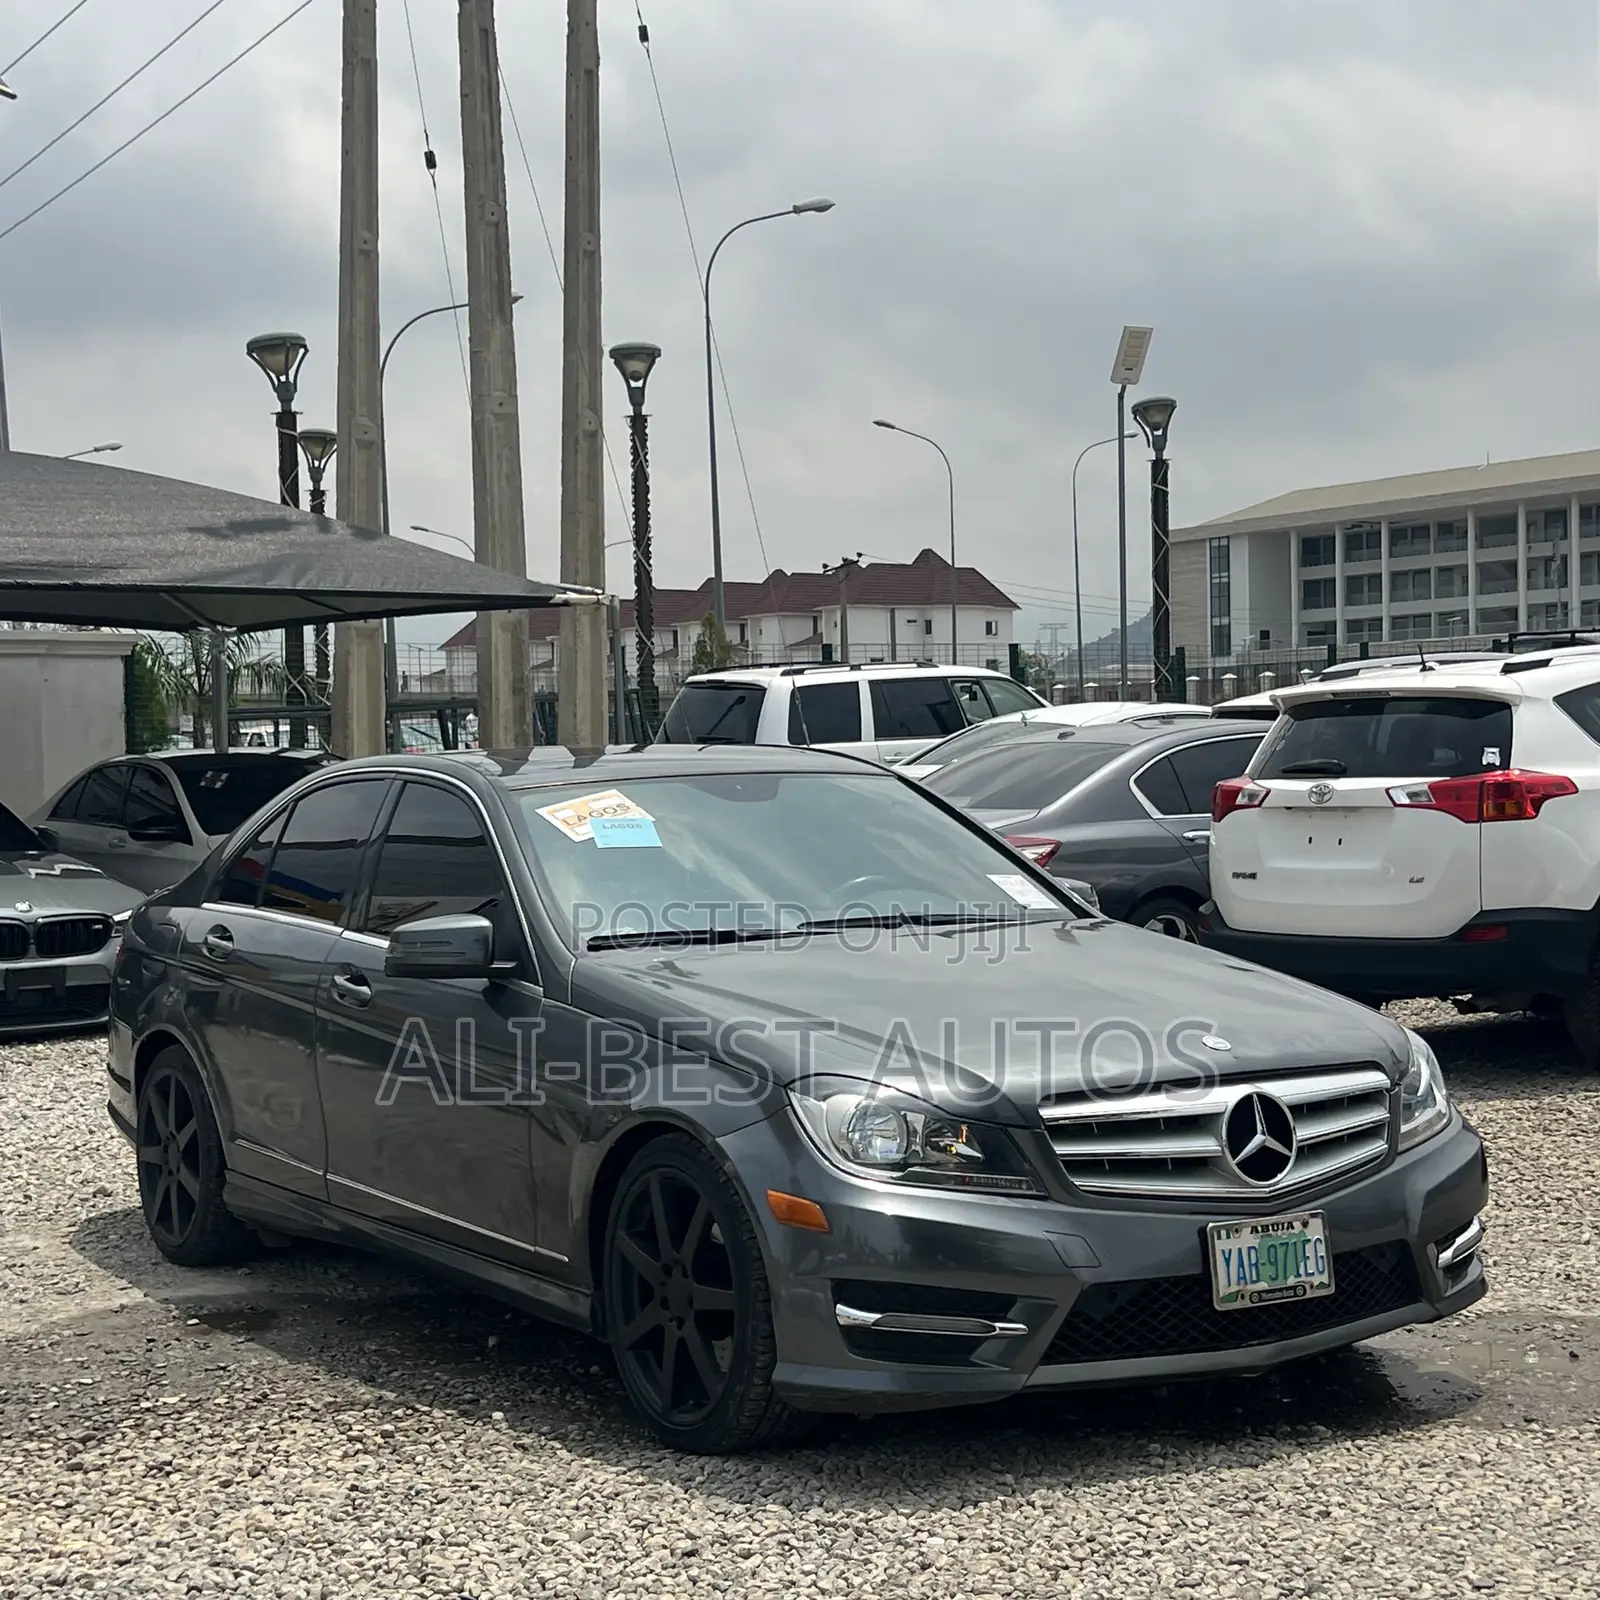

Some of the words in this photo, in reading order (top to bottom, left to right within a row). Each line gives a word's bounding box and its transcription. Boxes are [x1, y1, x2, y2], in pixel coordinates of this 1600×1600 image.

[562, 803, 631, 826] LAGOS
[1249, 1221, 1296, 1235] ABUJA
[1221, 1236, 1326, 1288] YAB-971EG
